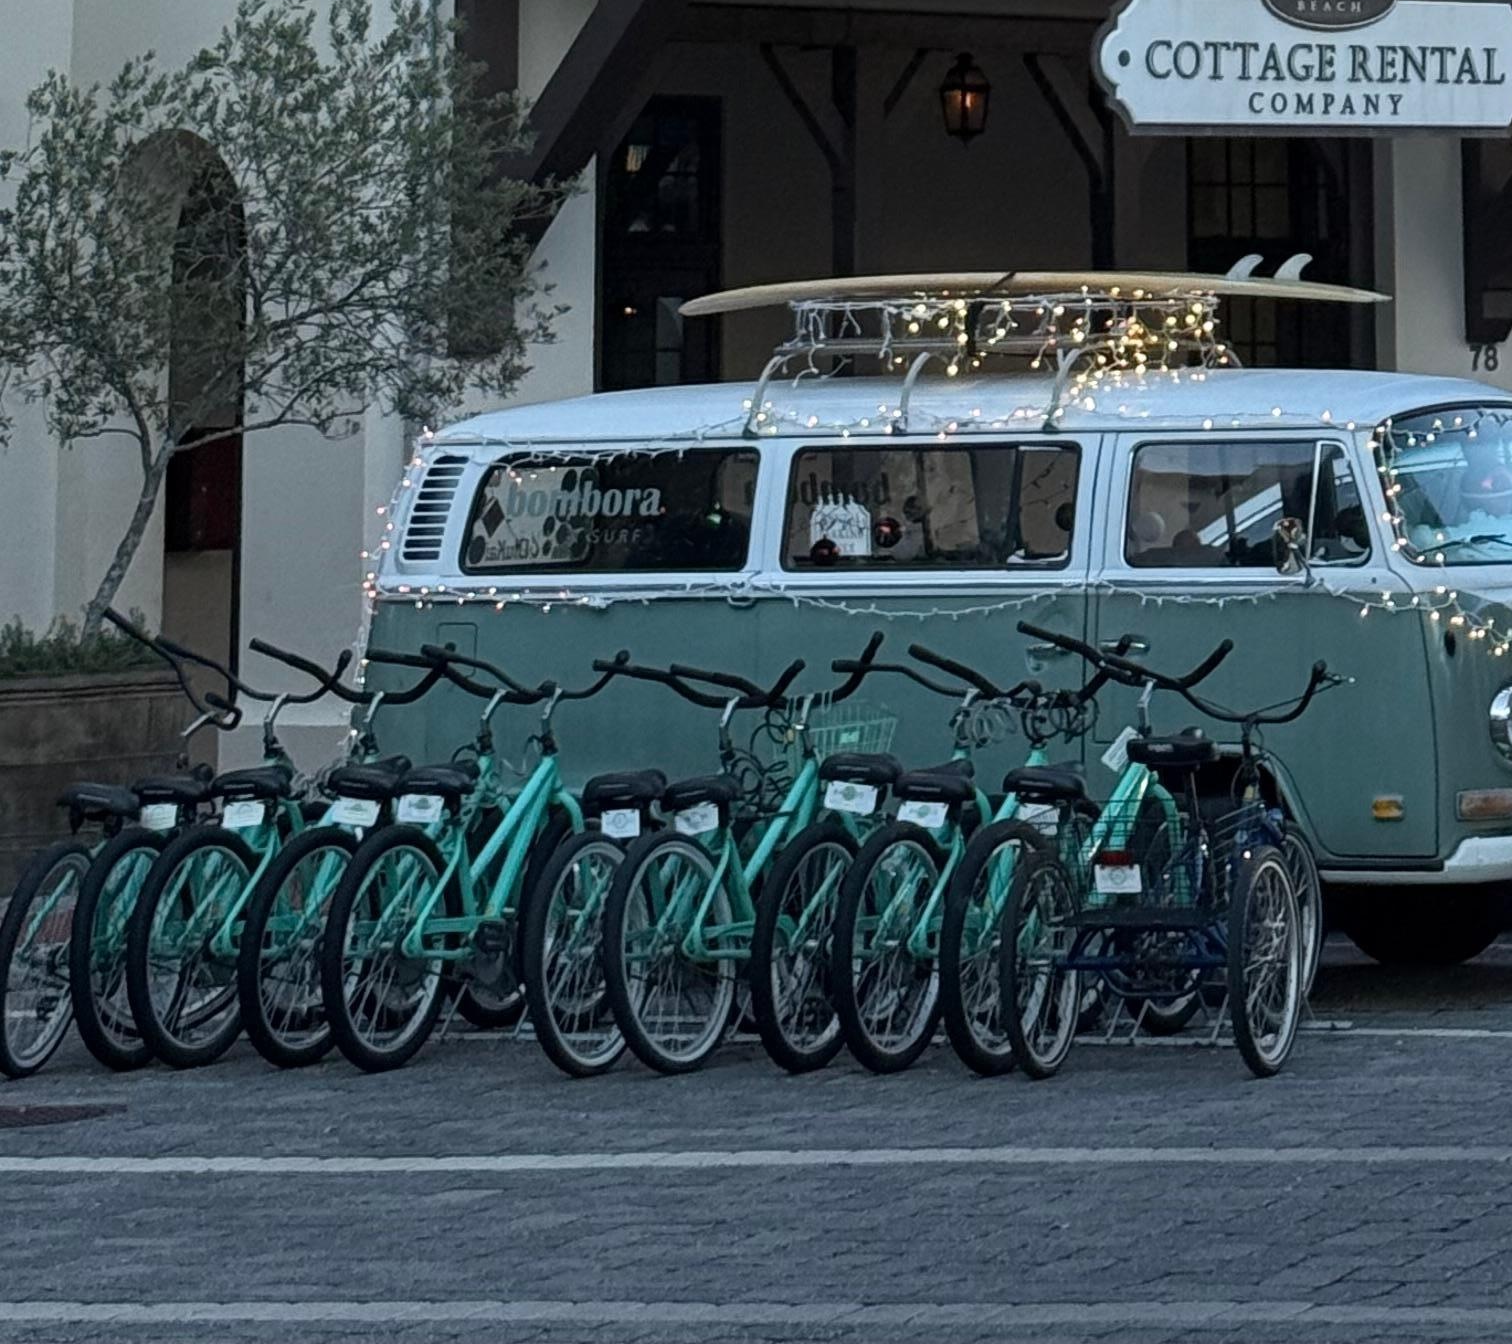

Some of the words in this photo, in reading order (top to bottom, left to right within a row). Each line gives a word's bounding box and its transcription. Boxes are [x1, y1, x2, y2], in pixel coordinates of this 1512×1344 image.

[1297, 0, 1362, 13] BEACH
[1145, 39, 1337, 82] COTTAGE
[1347, 44, 1506, 85] RENTAL
[1248, 91, 1404, 116] COMPANY
[1469, 344, 1498, 371] 78
[591, 528, 642, 545] SURF
